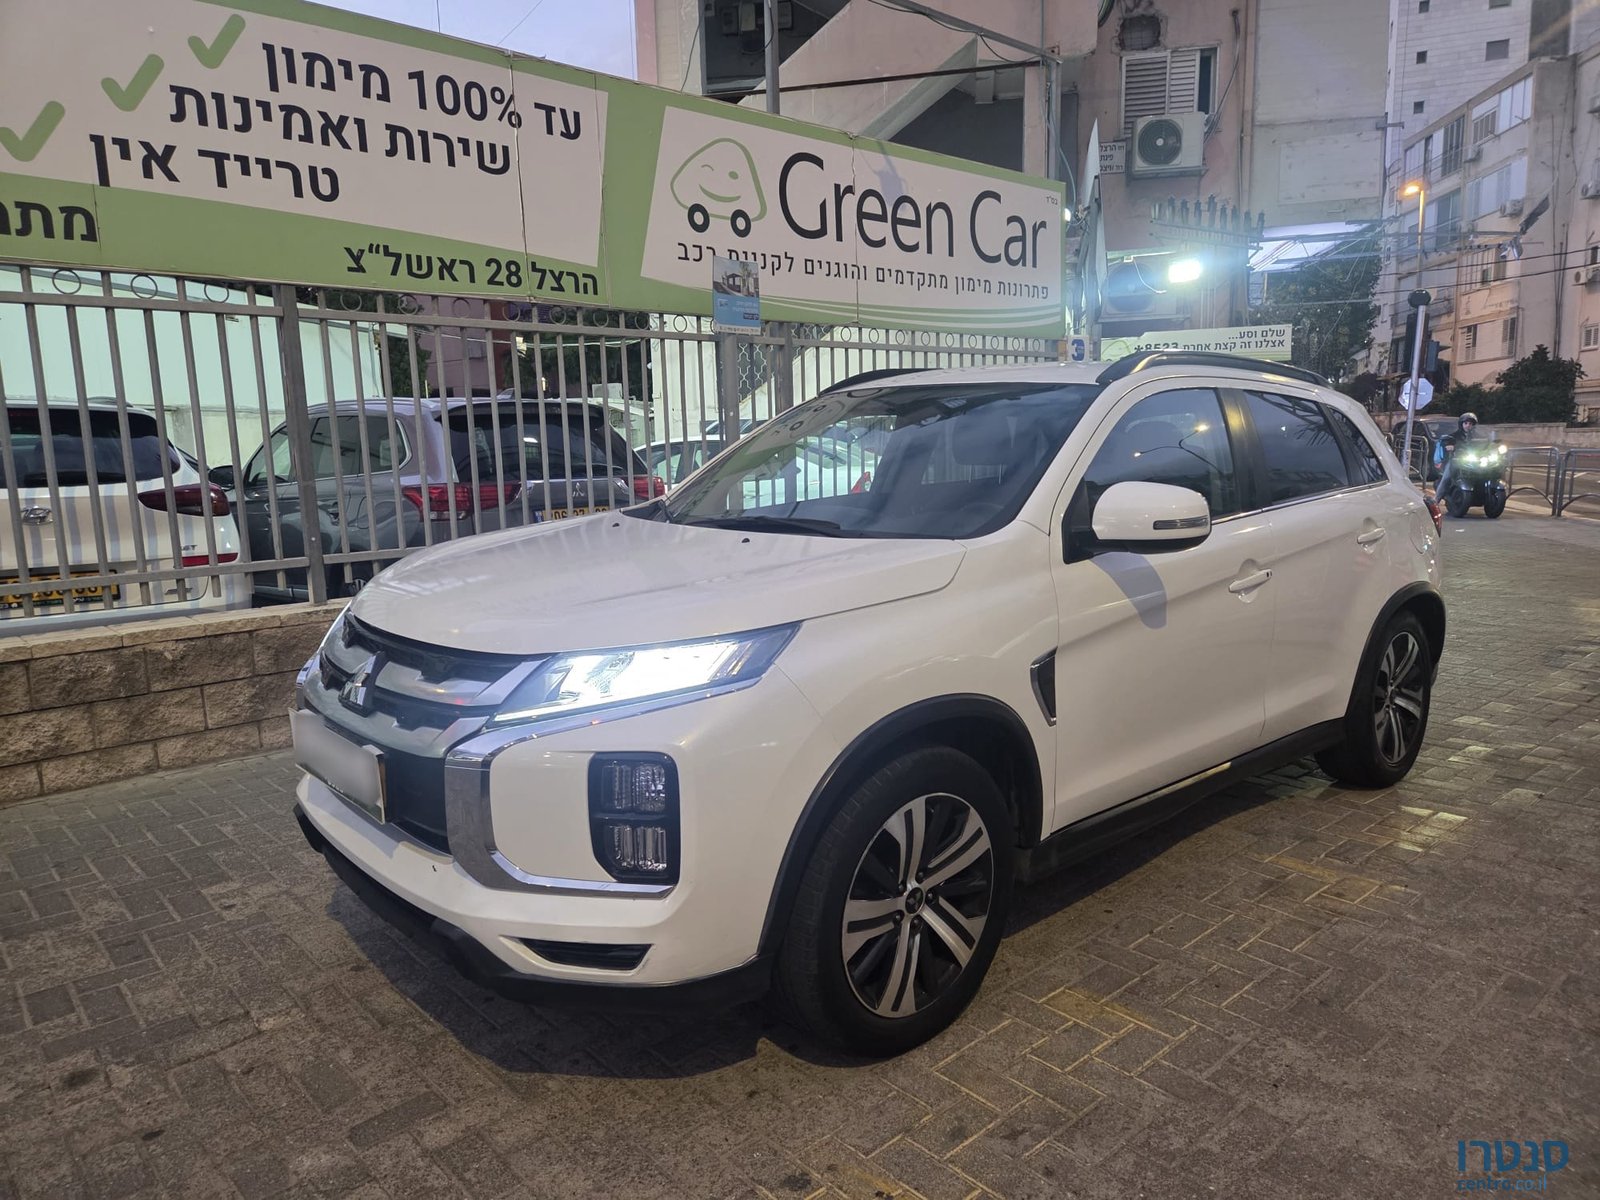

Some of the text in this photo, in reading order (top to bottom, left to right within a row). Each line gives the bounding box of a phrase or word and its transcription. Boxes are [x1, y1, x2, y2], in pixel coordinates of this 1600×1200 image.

[261, 42, 582, 142] עד 100% מימון
[169, 84, 511, 177] שירות ואמינות
[90, 133, 340, 203] טרייד אין
[779, 152, 1047, 268] Green Car
[486, 257, 523, 289] 28
[531, 262, 599, 296] הרצל
[805, 258, 868, 283] והוגנים
[876, 267, 949, 291] מתקדמים
[955, 276, 992, 295] מימון
[998, 281, 1049, 301] פתרונות
[1239, 340, 1252, 349] זה
[1255, 339, 1285, 349] אצלנו
[1261, 329, 1286, 338] שלם
[1214, 341, 1236, 352] קצת
